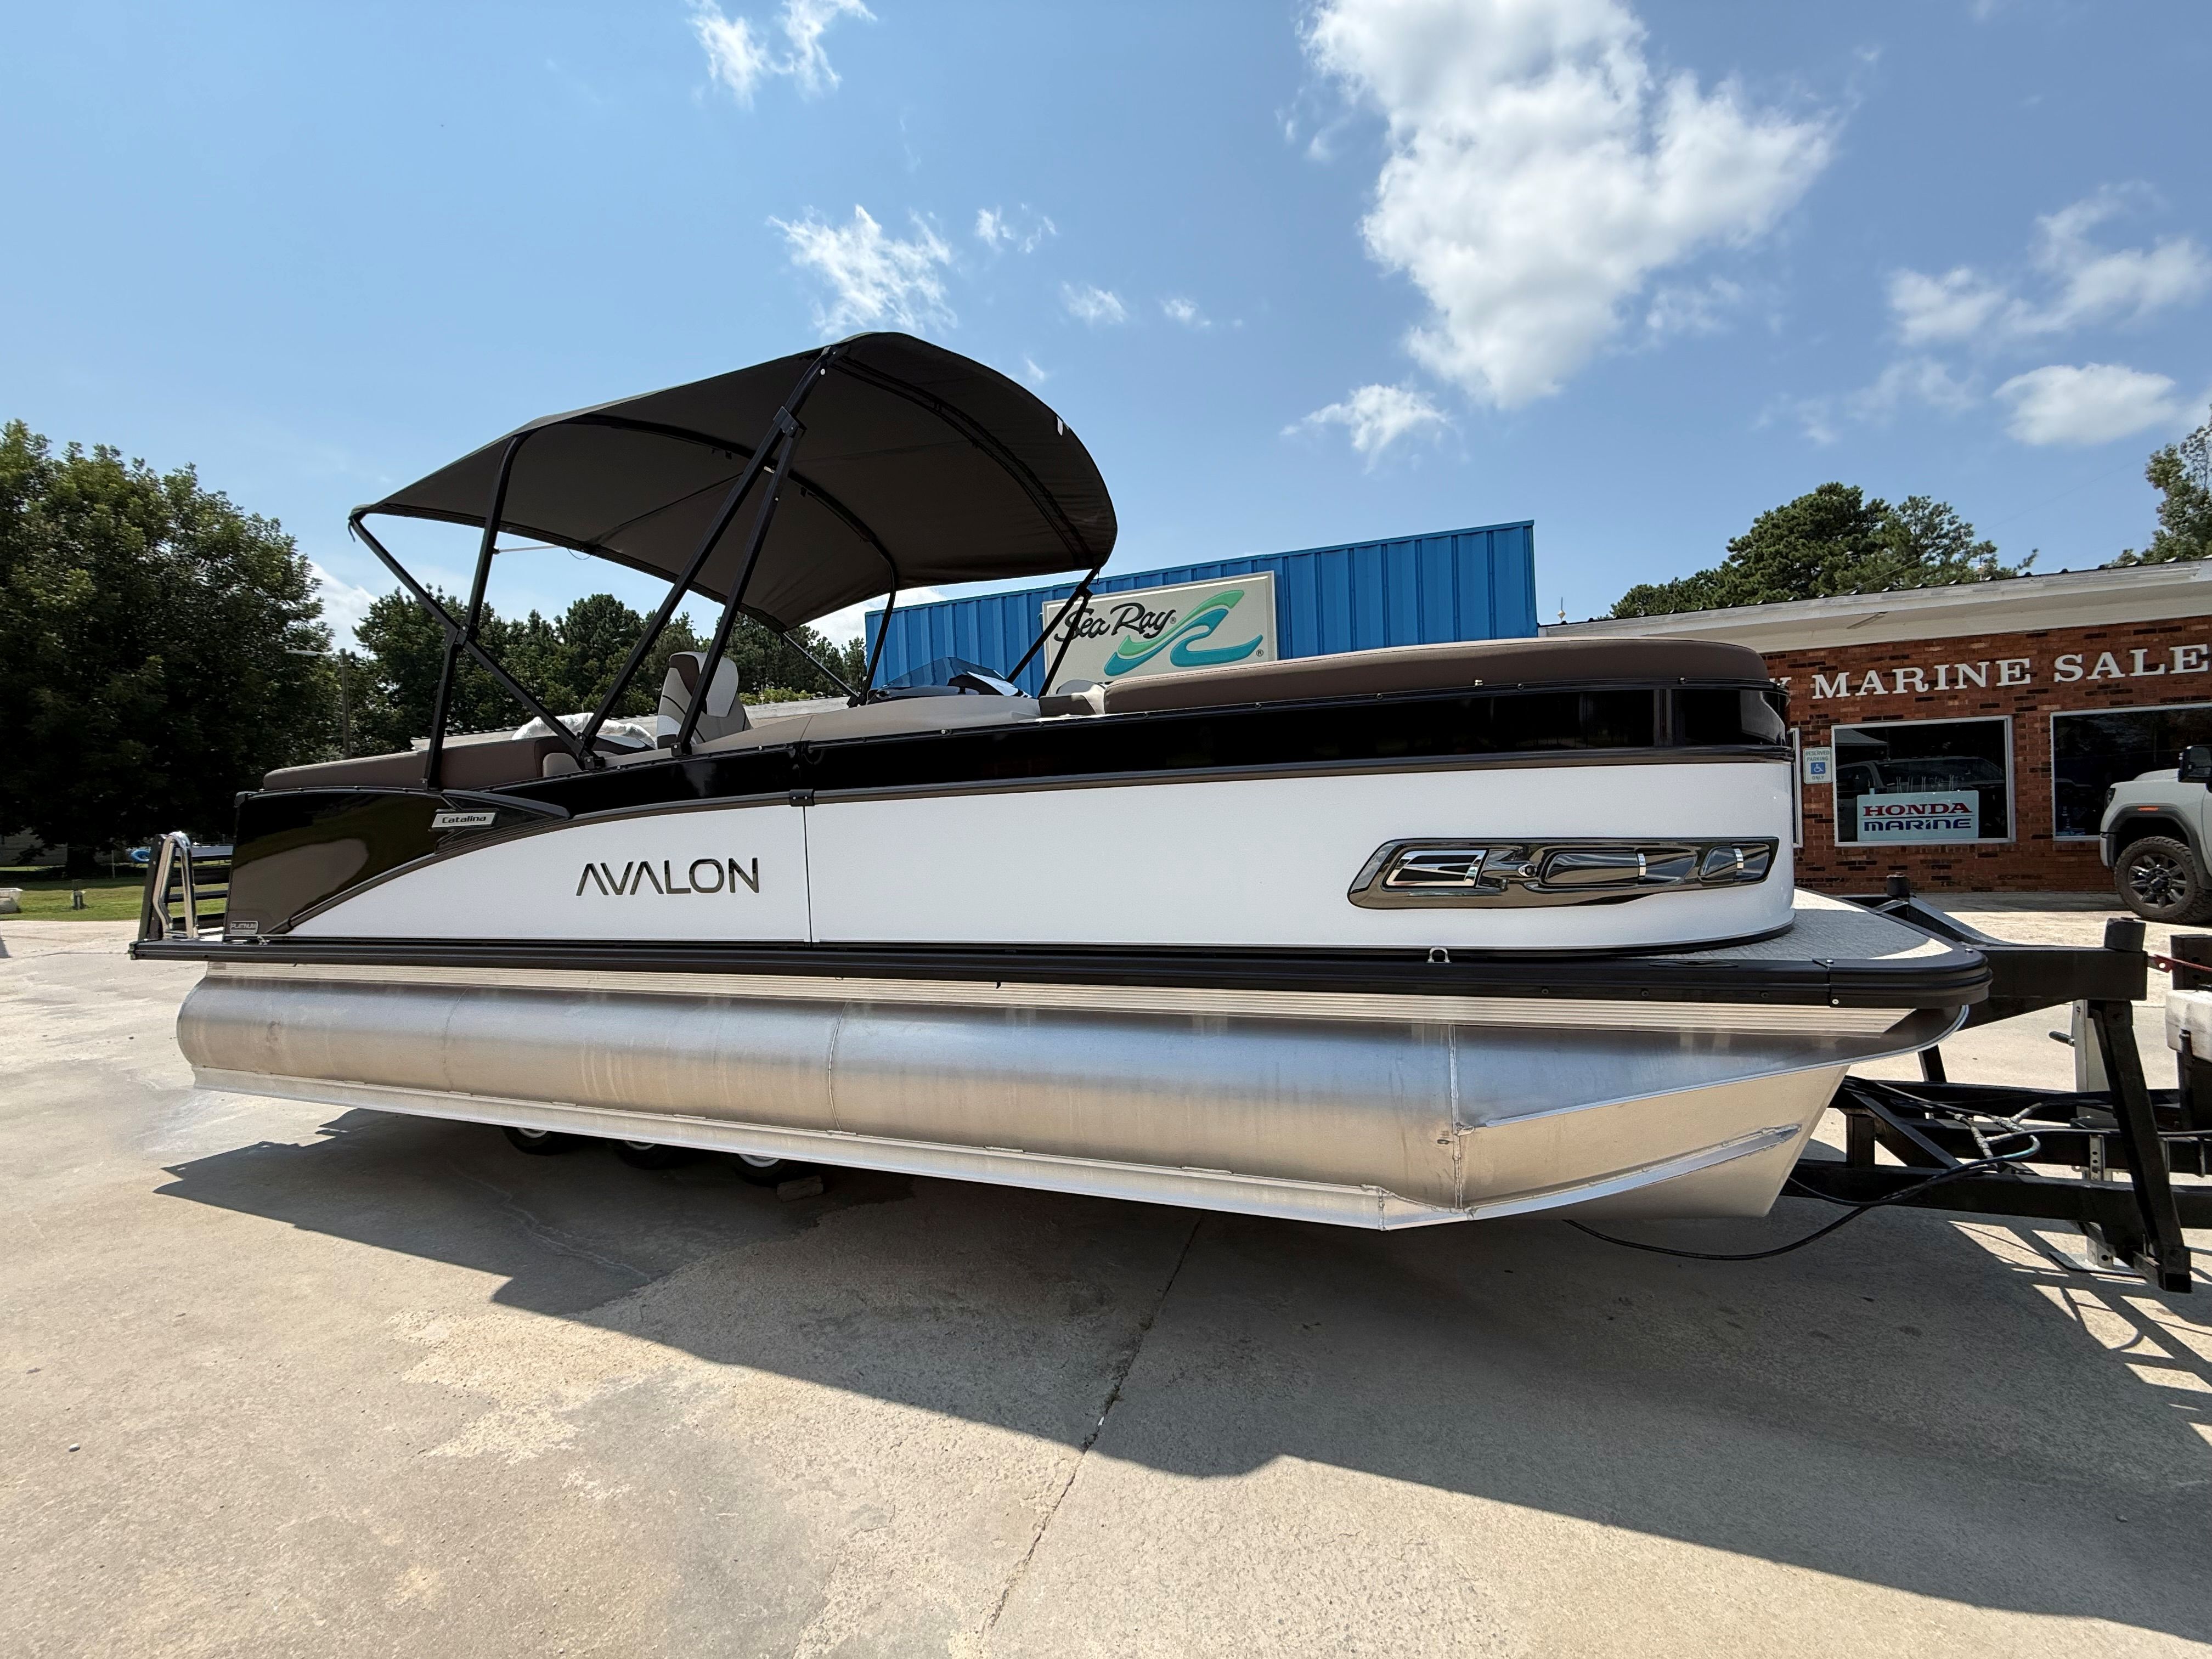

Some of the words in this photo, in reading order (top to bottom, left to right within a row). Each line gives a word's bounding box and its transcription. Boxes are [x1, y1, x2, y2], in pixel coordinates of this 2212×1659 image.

[1054, 608, 1111, 642] Sea
[1812, 658, 2031, 699] MARINE
[2053, 644, 2209, 682] SALE
[442, 815, 487, 823] Catalina
[1863, 802, 1973, 817] HONDA
[575, 857, 760, 896] AVALON
